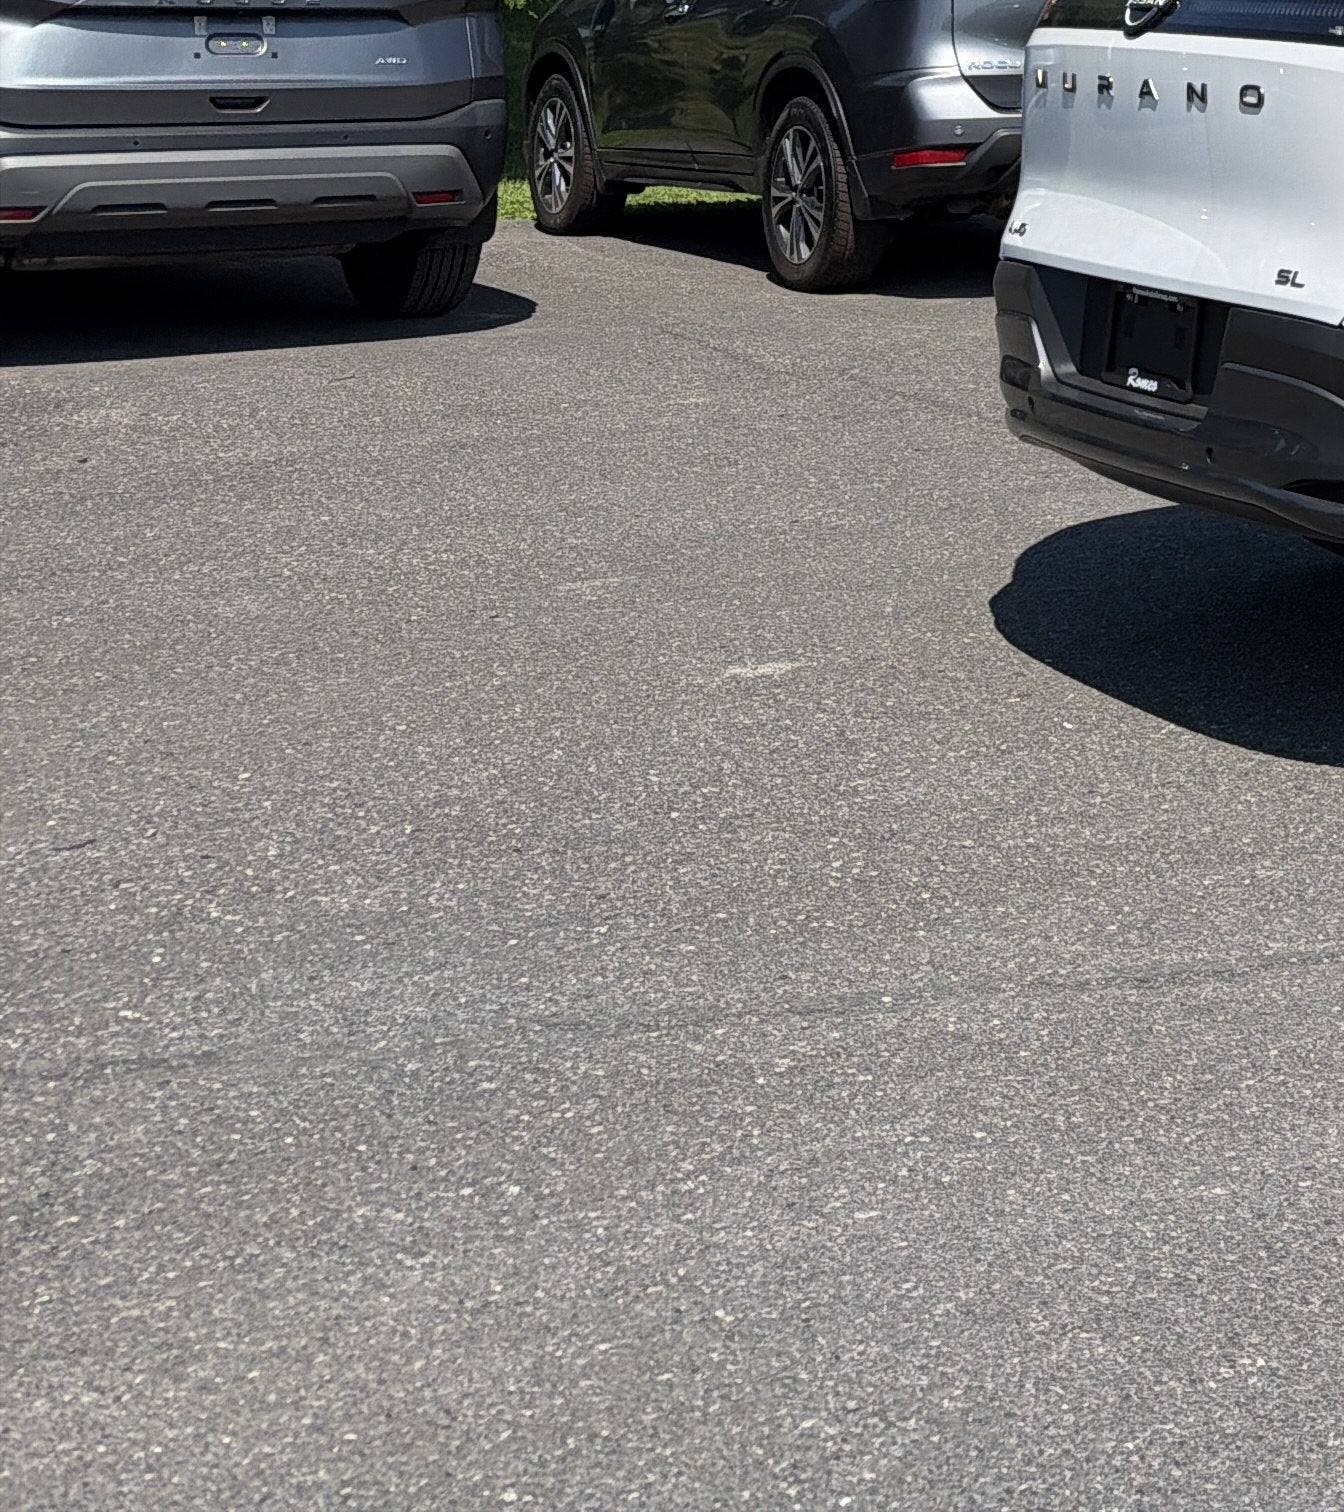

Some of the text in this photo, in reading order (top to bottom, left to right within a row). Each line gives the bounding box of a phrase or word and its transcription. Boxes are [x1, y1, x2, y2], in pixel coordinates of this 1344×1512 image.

[374, 56, 408, 66] AWD
[1034, 67, 1265, 108] MURANO
[1274, 268, 1306, 289] SL
